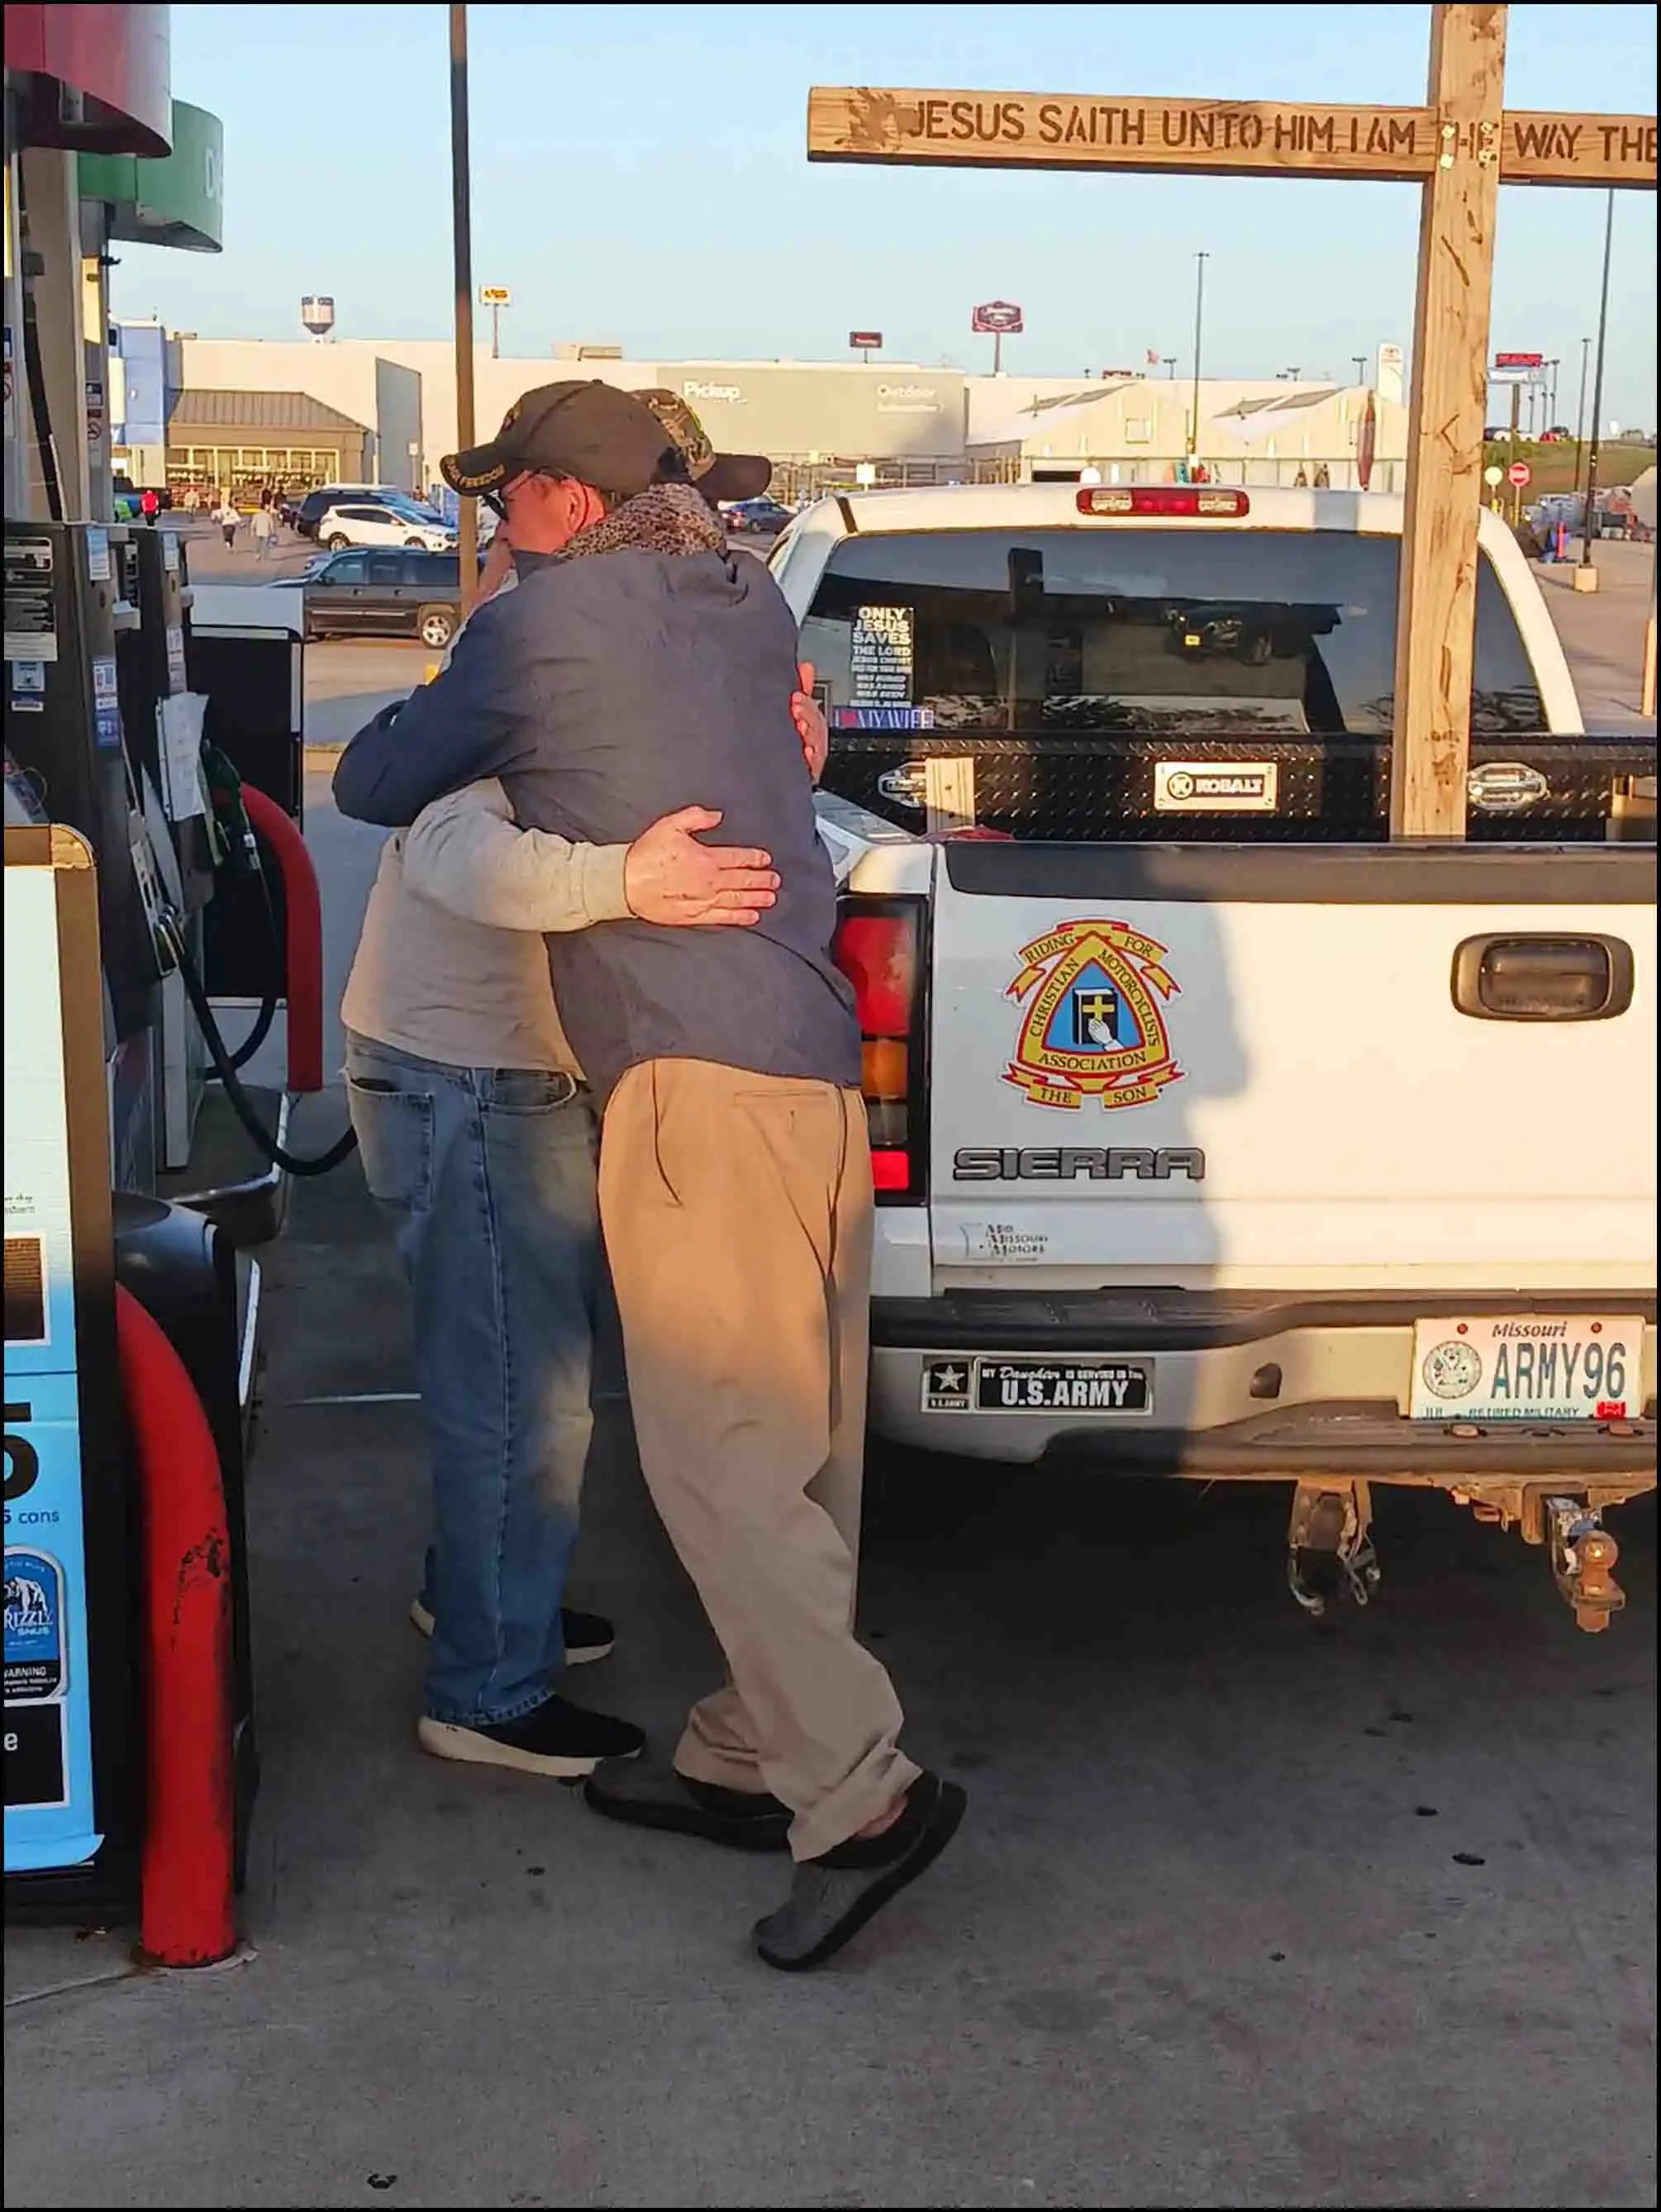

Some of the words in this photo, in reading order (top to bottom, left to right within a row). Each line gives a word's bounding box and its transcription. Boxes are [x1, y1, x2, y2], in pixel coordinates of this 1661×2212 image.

[909, 99, 1025, 140] JESUS
[1038, 104, 1145, 145] SAITH
[1162, 109, 1264, 150] UNTO
[1350, 118, 1358, 152] I
[1366, 117, 1416, 154] AM
[1597, 125, 1656, 163] THE
[683, 380, 741, 402] Pickup
[877, 384, 936, 397] Outdoor
[858, 607, 906, 620] ONLY
[854, 620, 910, 632] JESUS
[852, 632, 911, 645] SAVES
[878, 646, 911, 656] LORD
[1196, 778, 1263, 793] KOBALT
[1025, 935, 1074, 962] RIDING
[1123, 935, 1154, 958] FOR
[1030, 959, 1079, 1037] CHRISTIAN
[1039, 1051, 1147, 1072] ASSOCIATION
[1040, 1087, 1072, 1103] THE
[1113, 1087, 1147, 1102] SON
[953, 1147, 1206, 1180] SIERRA
[1492, 1322, 1568, 1339] Missouri
[1490, 1342, 1627, 1400] ARMY96
[19, 1510, 59, 1524] cans
[4, 1666, 46, 1678] ARNING
